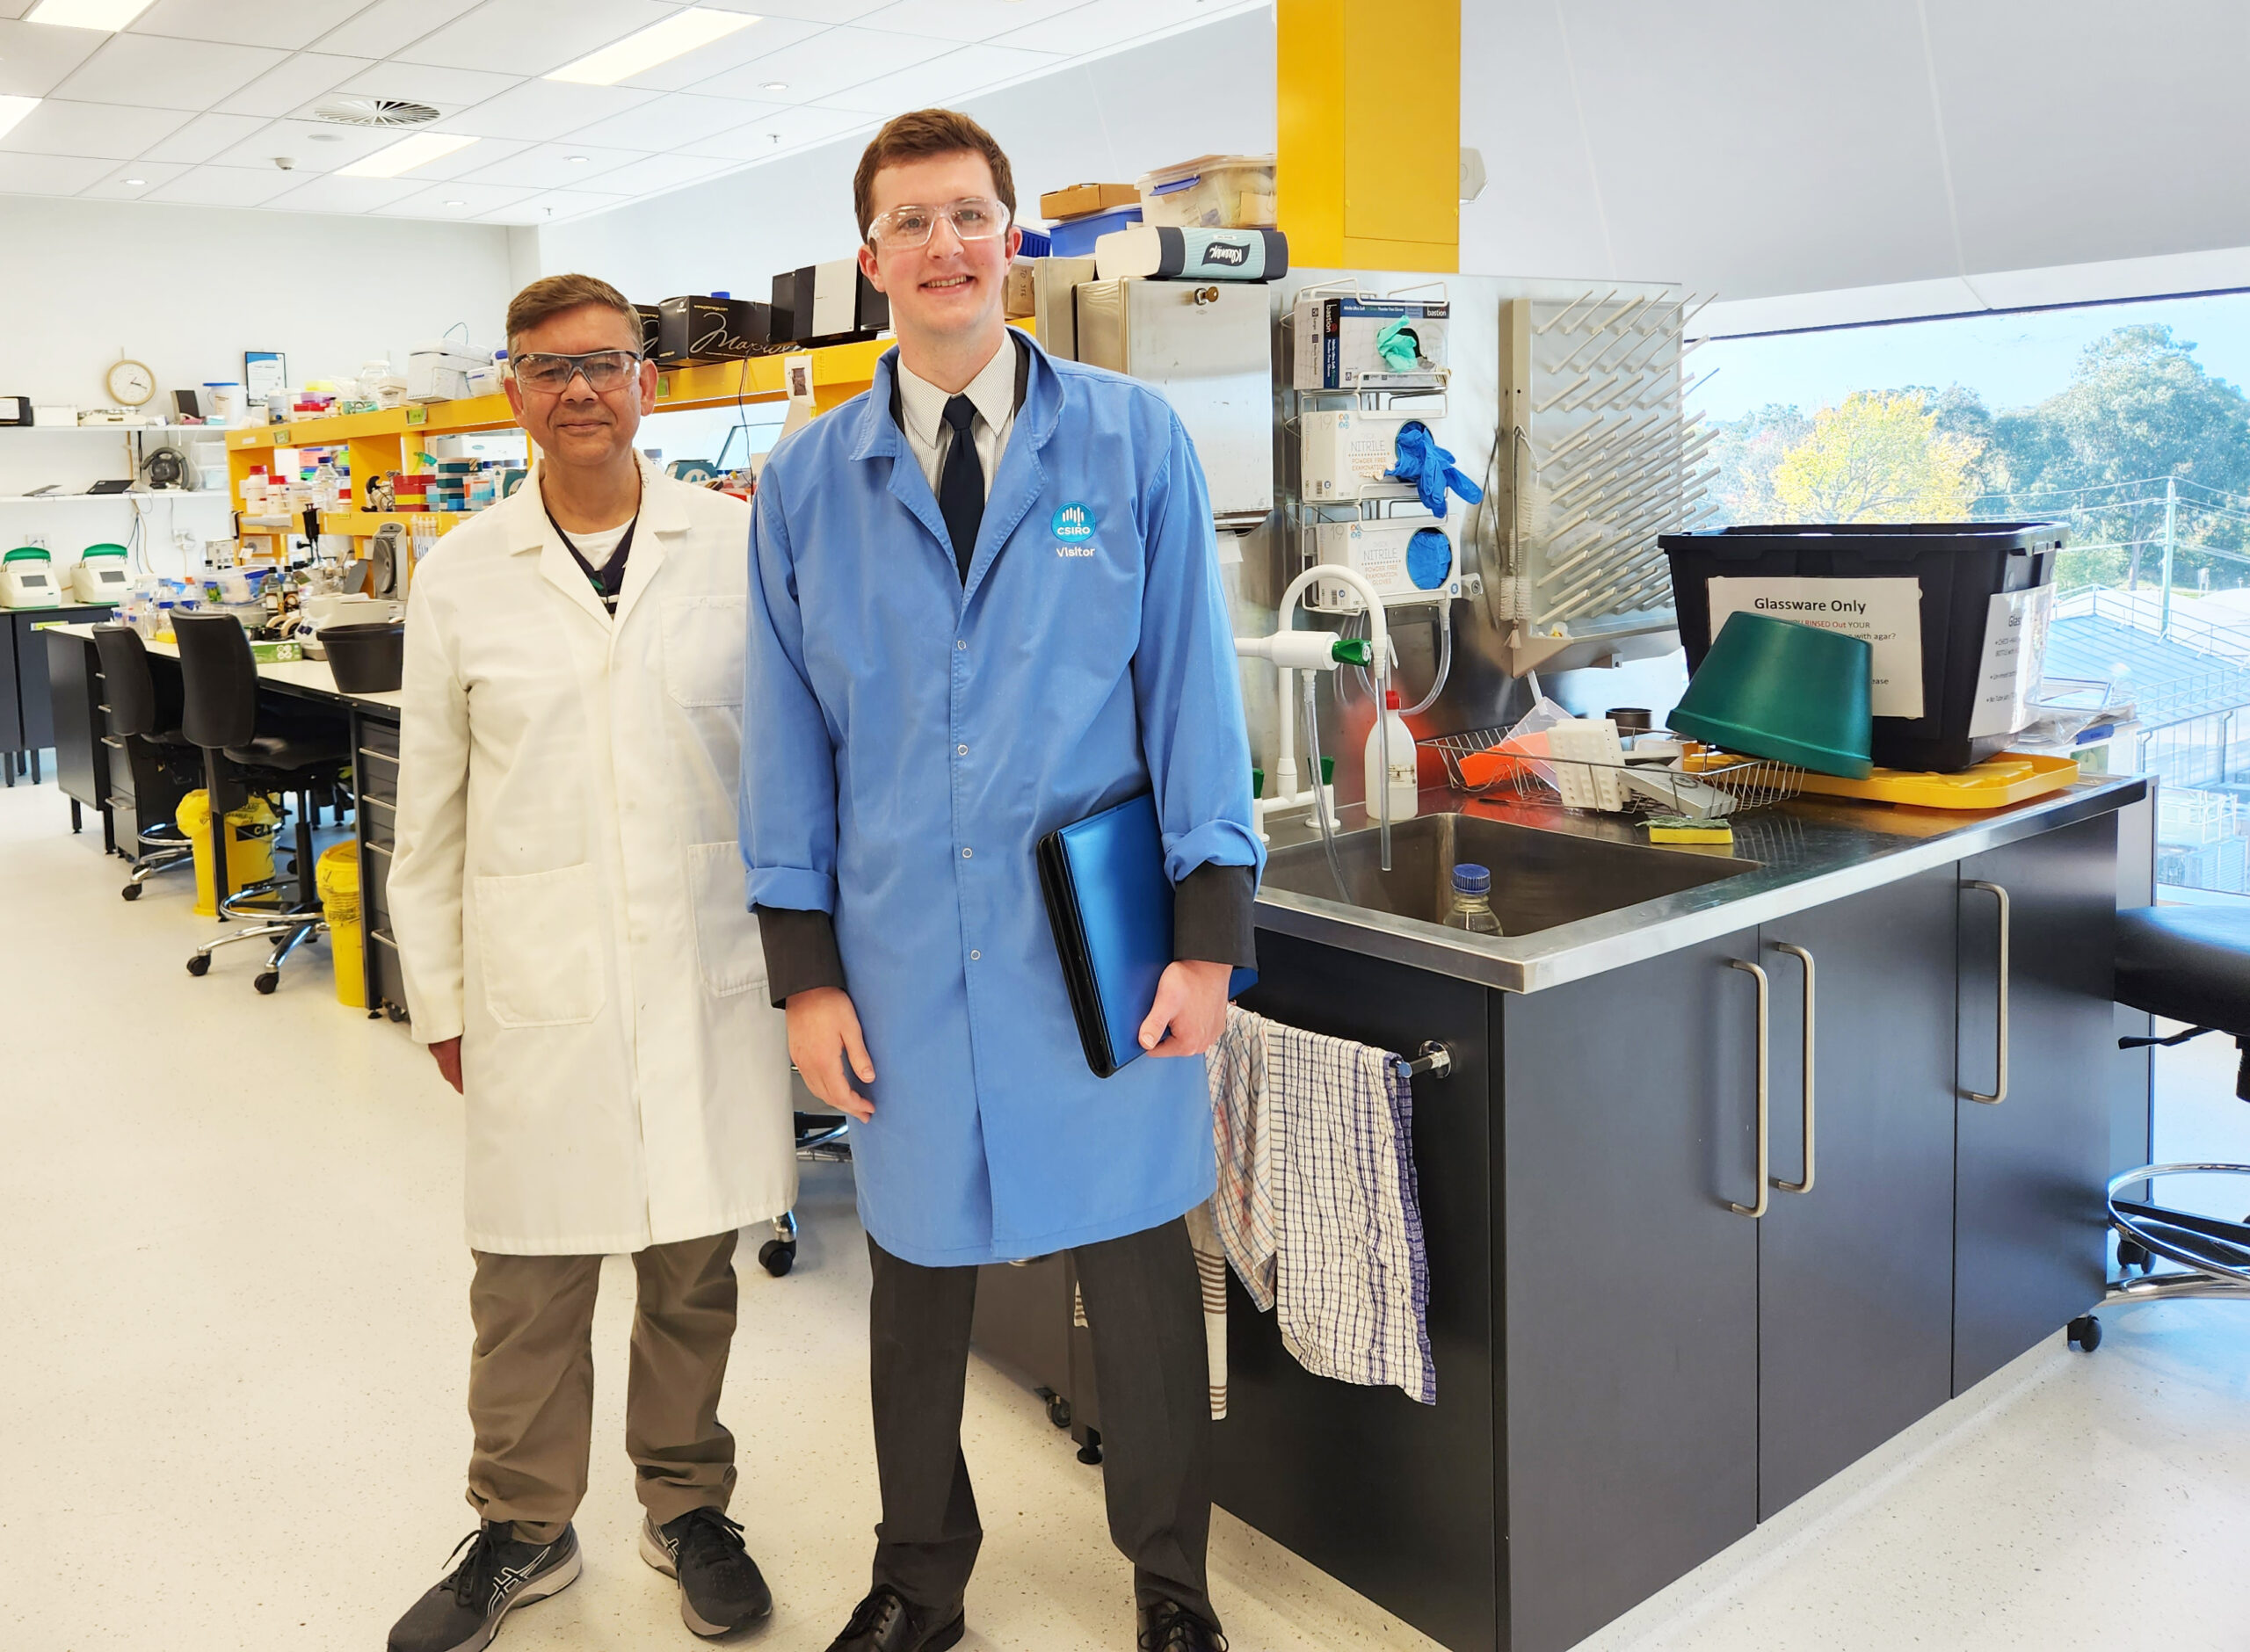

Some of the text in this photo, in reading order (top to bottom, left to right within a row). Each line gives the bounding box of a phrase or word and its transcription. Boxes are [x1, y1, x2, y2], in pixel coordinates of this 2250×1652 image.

[1208, 245, 1243, 264] Kleenex
[1325, 303, 1338, 333] bastion
[1426, 307, 1447, 316] bastion
[1318, 414, 1332, 431] 19
[1351, 440, 1386, 452] NITRILE
[1056, 526, 1091, 535] CSIRO
[1330, 525, 1345, 541] 19
[1056, 547, 1095, 557] Visitor
[1363, 548, 1398, 561] NITRILE
[1754, 598, 1866, 614] Glassware Only
